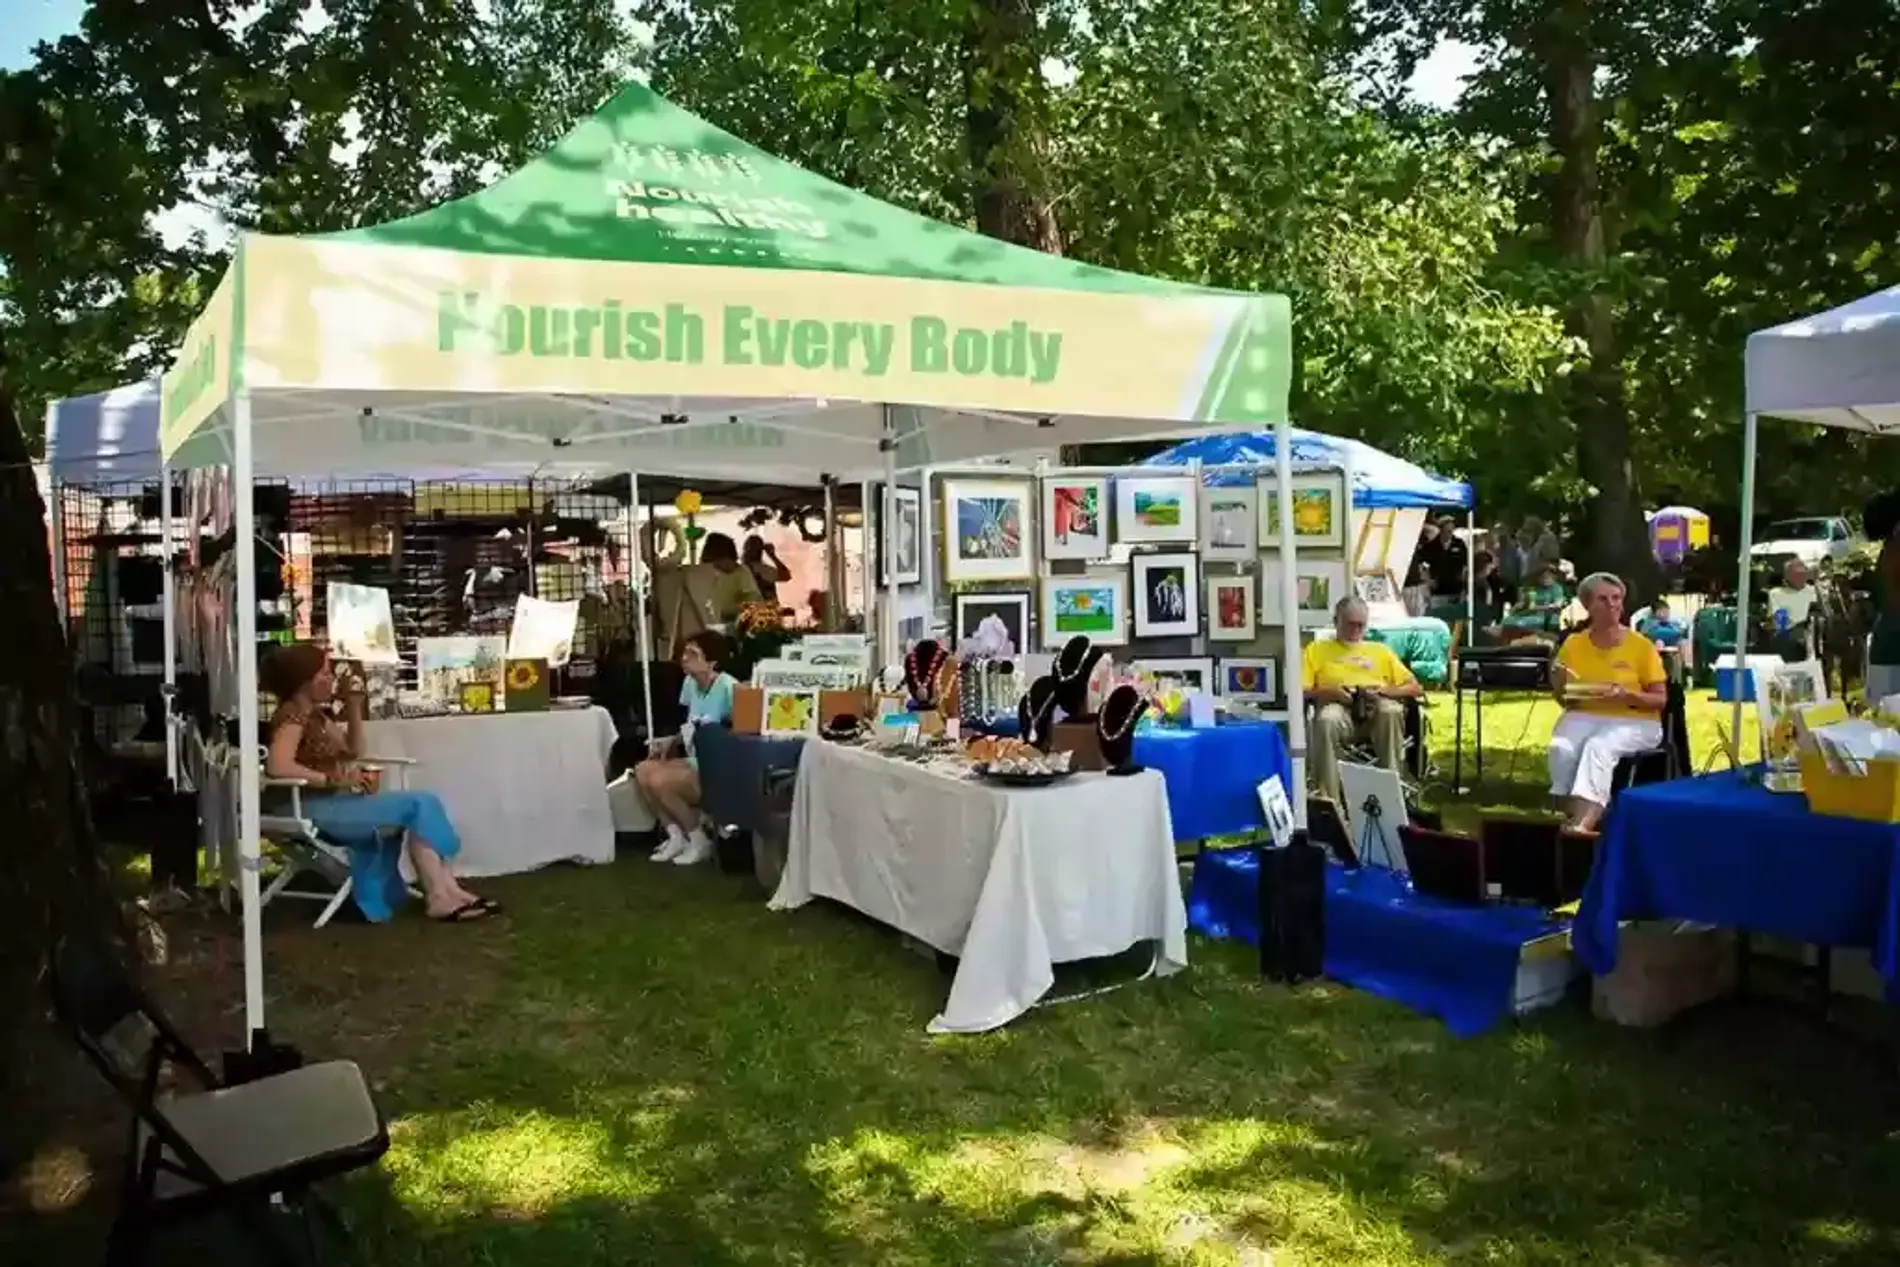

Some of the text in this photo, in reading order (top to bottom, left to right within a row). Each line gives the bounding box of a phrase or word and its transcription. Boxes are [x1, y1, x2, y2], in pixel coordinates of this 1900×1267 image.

[437, 291, 1062, 384] Nourish Every Body
